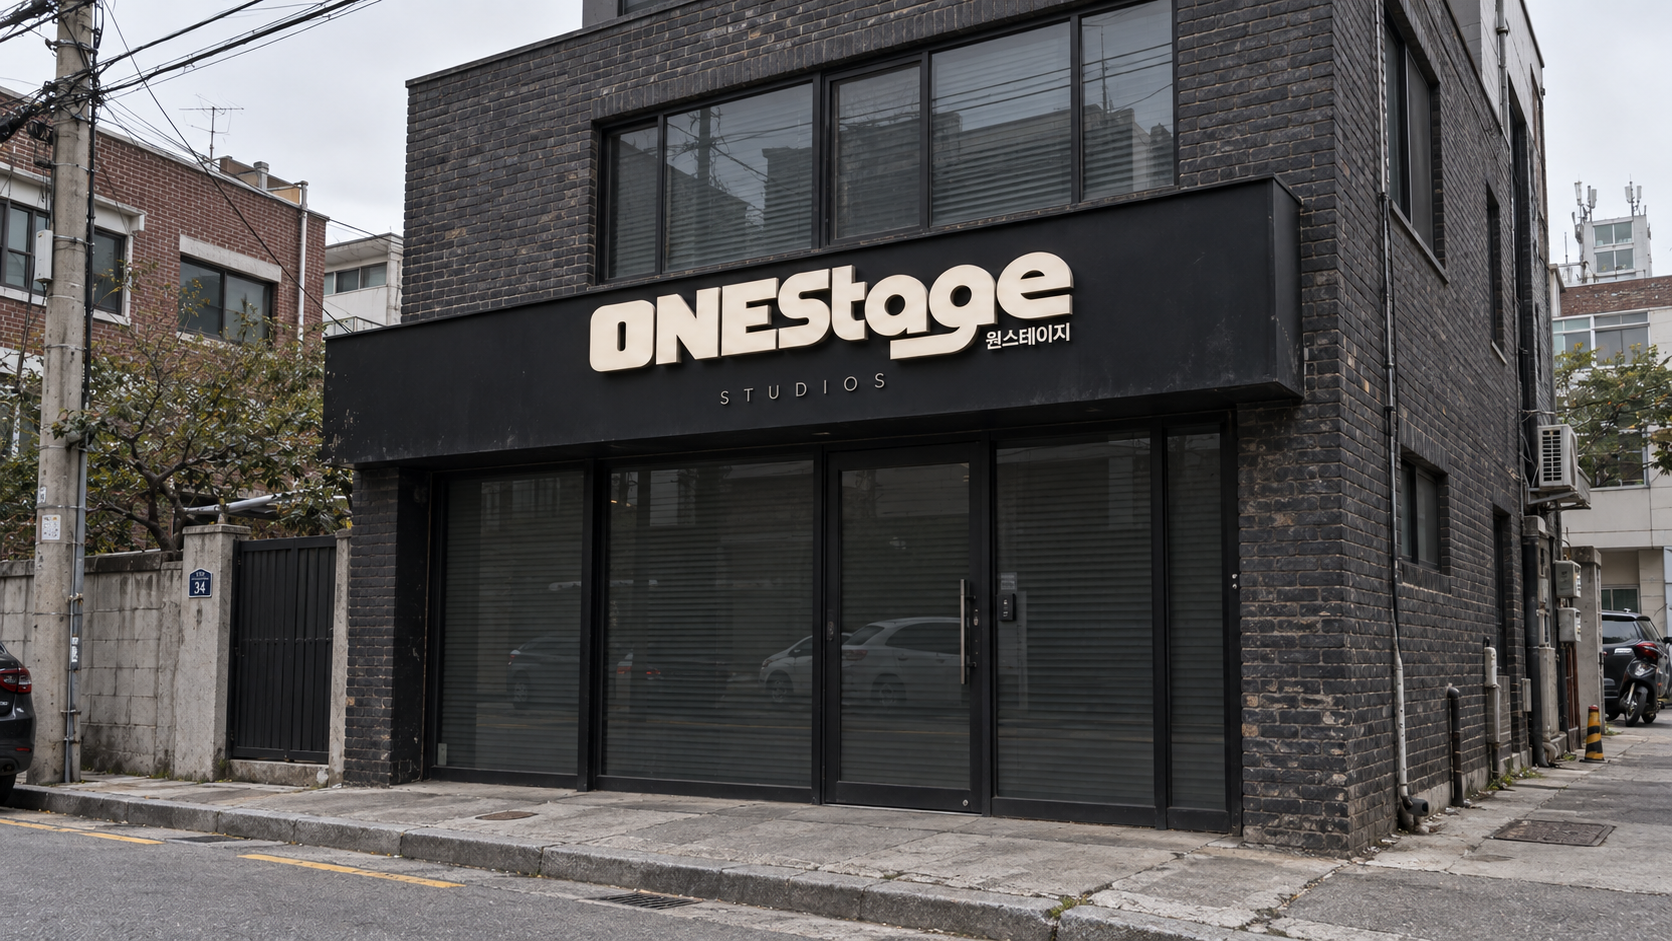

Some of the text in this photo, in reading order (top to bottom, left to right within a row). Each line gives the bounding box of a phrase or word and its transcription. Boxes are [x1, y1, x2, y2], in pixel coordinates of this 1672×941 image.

[590, 252, 1074, 373] ONEStage
[985, 322, 1070, 350] 원스테이지
[720, 372, 889, 406] STUDIOS
[194, 581, 206, 594] 34
